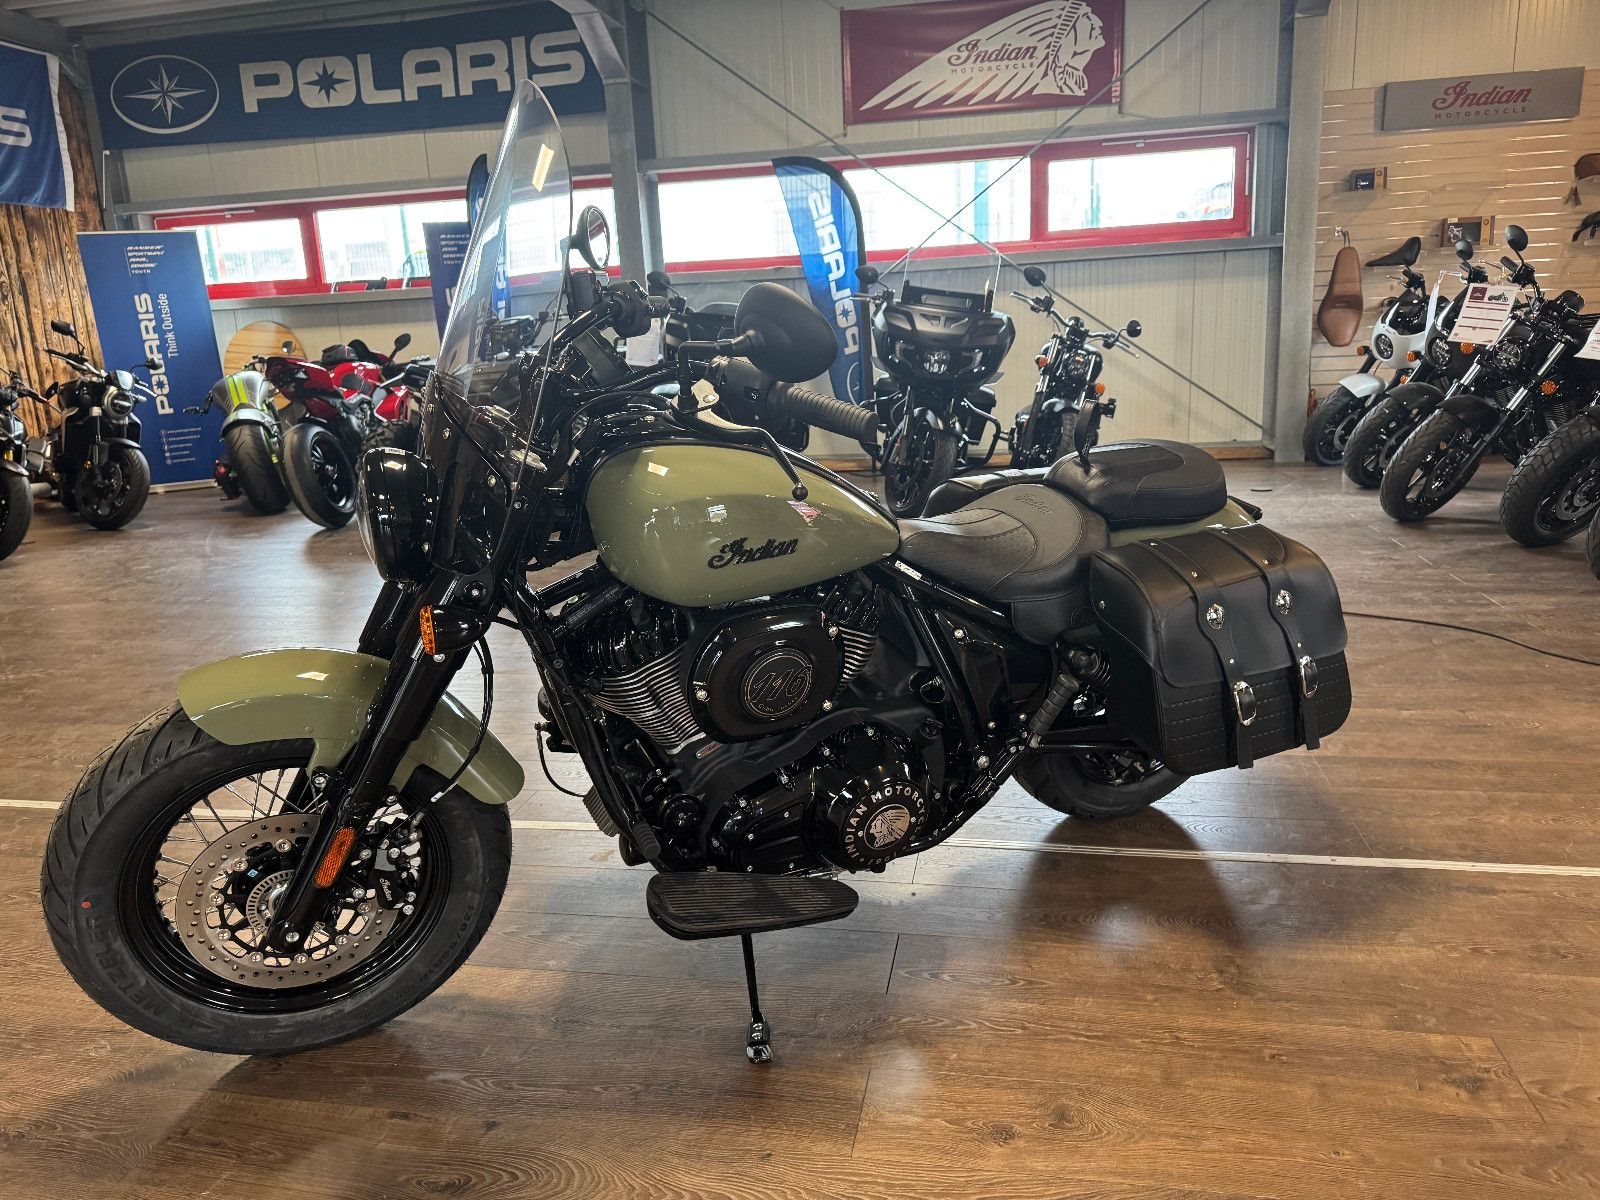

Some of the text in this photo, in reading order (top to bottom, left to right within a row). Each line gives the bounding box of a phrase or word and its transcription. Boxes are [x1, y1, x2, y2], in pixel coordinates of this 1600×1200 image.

[947, 39, 1038, 67] Indian
[951, 62, 1035, 74] MOTORCYCLE
[239, 29, 586, 113] POLARIS
[1432, 81, 1532, 110] Indian
[1435, 107, 1526, 119] MOTORCYCLE
[158, 293, 178, 358] Think Outside
[134, 292, 174, 415] POLARIS
[707, 537, 799, 569] Indian
[748, 667, 809, 703] 116
[844, 803, 868, 858] INDIAN
